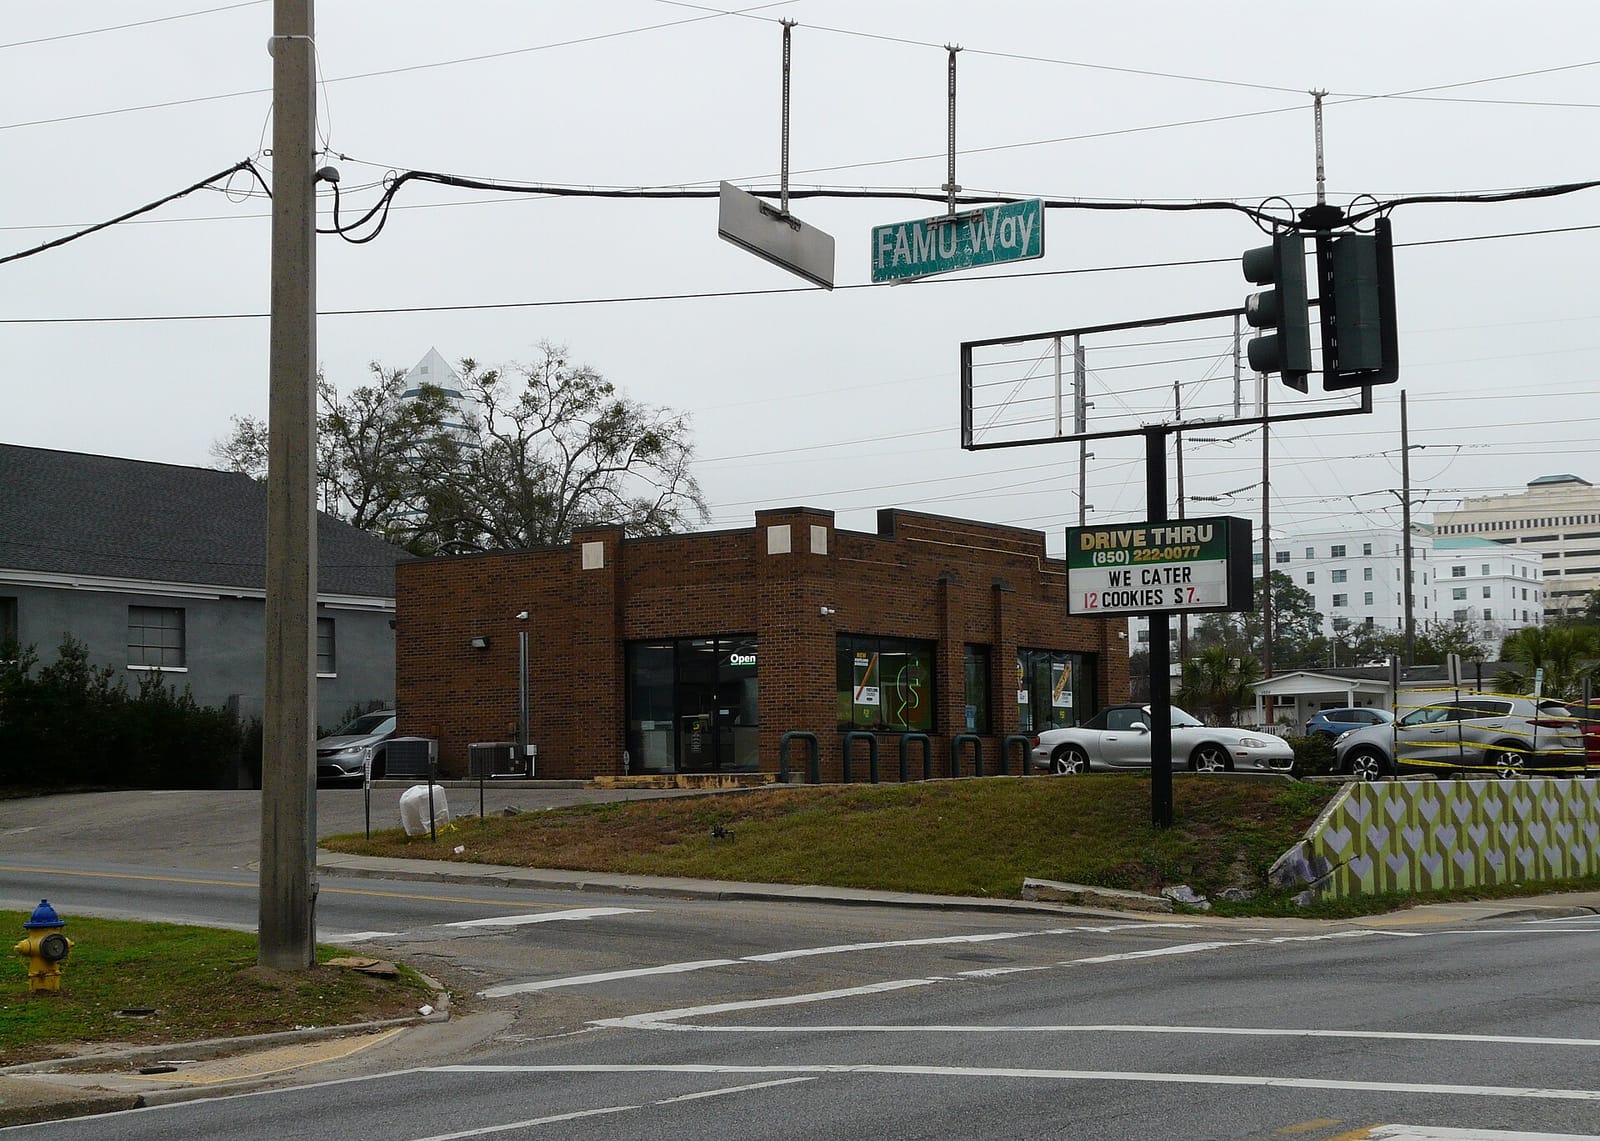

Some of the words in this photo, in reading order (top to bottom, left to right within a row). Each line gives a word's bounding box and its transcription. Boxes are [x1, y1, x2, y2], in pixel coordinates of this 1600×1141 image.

[878, 221, 957, 269] FAMU
[969, 206, 1035, 256] Way
[1080, 529, 1147, 551] DRIVE
[1151, 524, 1213, 546] THRU
[1092, 550, 1130, 566] (850)
[1133, 545, 1201, 561] 222-0077
[1108, 570, 1131, 587] WE
[1141, 566, 1192, 585] CATER
[1084, 592, 1098, 608] 12
[1102, 589, 1163, 608] COOKIES
[730, 653, 756, 665] Open
